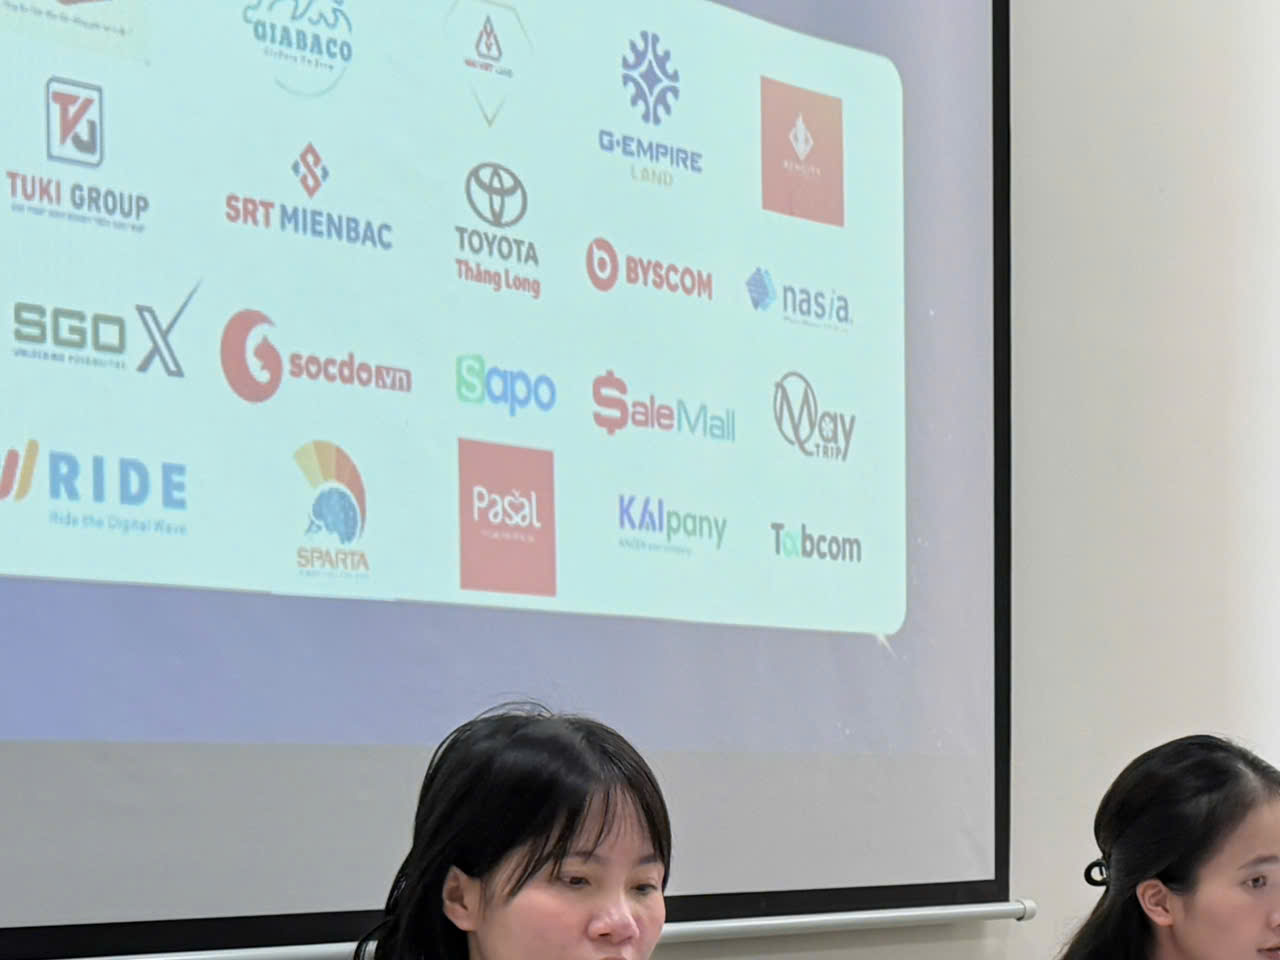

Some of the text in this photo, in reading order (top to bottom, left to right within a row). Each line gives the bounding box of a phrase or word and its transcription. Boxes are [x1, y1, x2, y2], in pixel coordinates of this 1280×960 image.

[6, 171, 62, 206] TUKI
[70, 183, 150, 220] GROUP
[225, 194, 392, 250] SRT MIENBAC
[455, 226, 539, 266] TOYOTA
[504, 268, 541, 299] Long
[625, 255, 713, 301] BYSCOM
[14, 301, 126, 354] SGO
[456, 354, 557, 417] Sapo
[49, 451, 188, 510] RIDE
[297, 545, 370, 571] SPARTA
